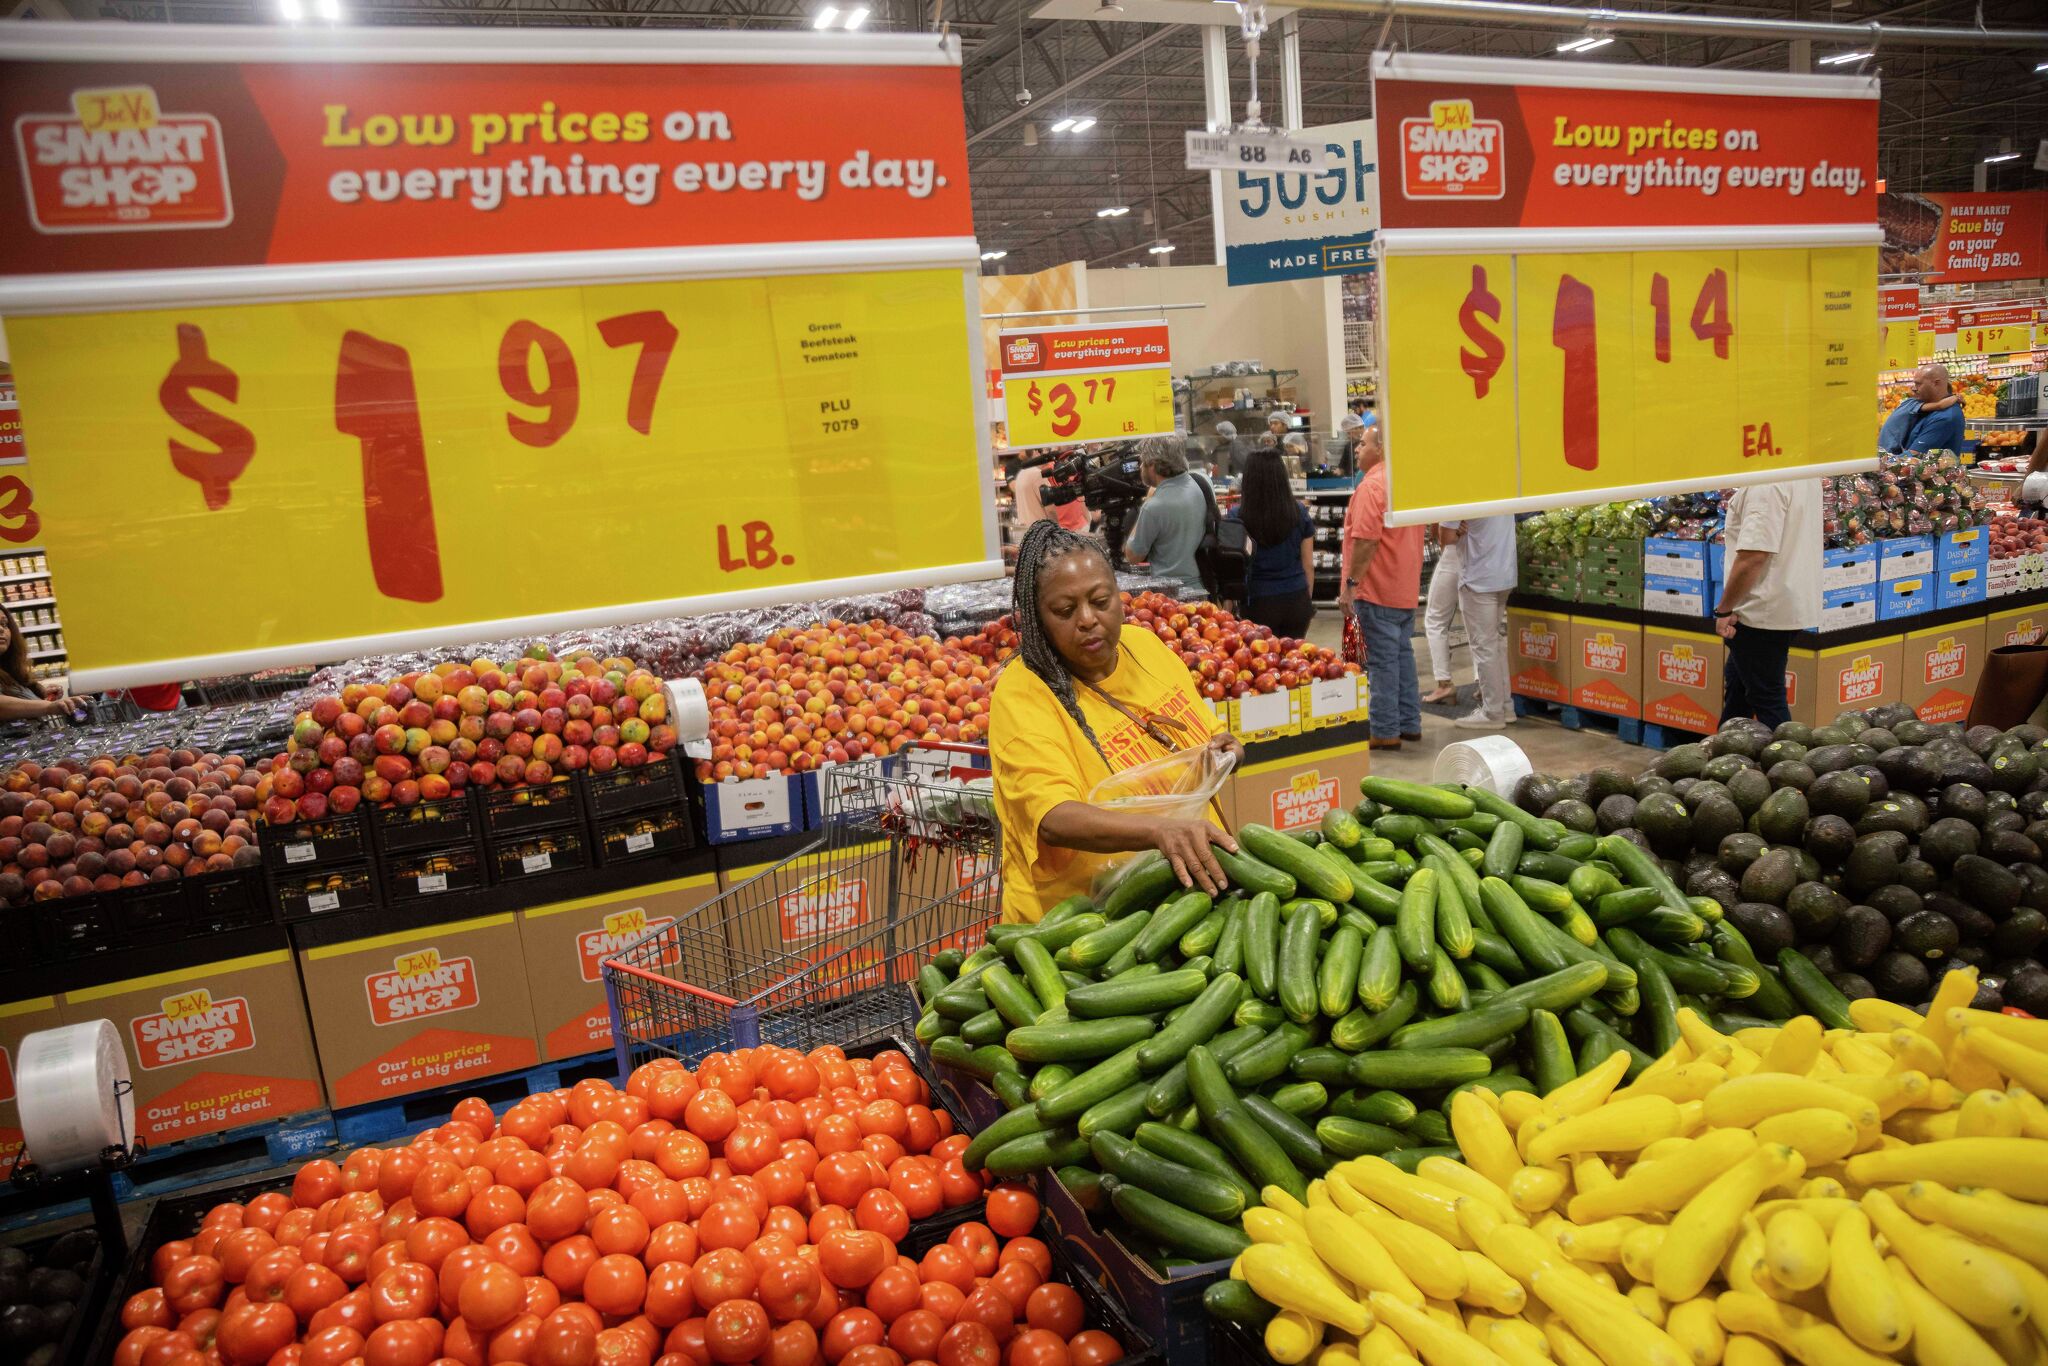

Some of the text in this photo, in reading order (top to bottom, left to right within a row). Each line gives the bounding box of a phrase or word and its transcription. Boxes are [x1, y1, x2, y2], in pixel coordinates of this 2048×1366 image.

[322, 101, 733, 155] Low prices on
[1553, 116, 1759, 155] Low prices on
[33, 124, 208, 165] SMART
[1409, 125, 1497, 154] SMART
[1239, 145, 1312, 164] 88 A6
[1418, 154, 1489, 182] SHOP
[1553, 156, 1867, 196] everything every day.
[59, 165, 198, 207] SHOP
[328, 149, 948, 211] everything every day.
[1284, 210, 1345, 225] SUSHI
[1950, 205, 2011, 217] MEAT MARKET
[1950, 218, 2004, 236] Save big
[1948, 238, 1997, 254] on your
[1269, 253, 1318, 269] MADE
[1948, 252, 2022, 272] family BBQ.
[1824, 290, 1852, 299] YELLOW
[808, 322, 842, 333] Green
[800, 334, 857, 350] Beefsteak
[1009, 344, 1037, 353] SMART
[1053, 337, 1125, 349] Low prices on
[1054, 343, 1166, 360] everything every day.
[1829, 343, 1844, 352] PLU
[803, 349, 858, 364] Tomatoes
[1013, 352, 1035, 361] SHOP
[820, 399, 851, 413] PLU
[821, 418, 859, 434] 7079
[1742, 421, 1782, 458] EA.
[717, 521, 796, 574] LB.
[1522, 631, 1555, 648] SMART
[1525, 644, 1552, 658] SHOP
[1587, 641, 1624, 658] SMART
[1928, 647, 1964, 667] SMART
[1590, 655, 1621, 670] SHOP
[1662, 653, 1704, 672] SMART
[1931, 662, 1959, 680] SHOP
[1666, 668, 1699, 684] SHOP
[1842, 665, 1881, 686] SMART
[1582, 689, 1595, 697] Our
[1846, 681, 1876, 700] SHOP
[1655, 703, 1669, 712] Our
[1920, 707, 1934, 715] Our
[1937, 710, 1948, 719] big
[1277, 782, 1336, 810] SMART
[1283, 800, 1330, 826] SHOP
[784, 884, 860, 917] SMART
[795, 906, 857, 935] SHOP
[374, 962, 467, 999] SMART
[388, 986, 461, 1018] SHOP
[140, 1002, 241, 1043] SMART
[156, 1028, 236, 1063] SHOP
[377, 1042, 492, 1074] Our low prices
[381, 1053, 492, 1087] are a big deal.
[147, 1085, 271, 1120] Our low prices
[151, 1096, 272, 1133] are a big deal.
